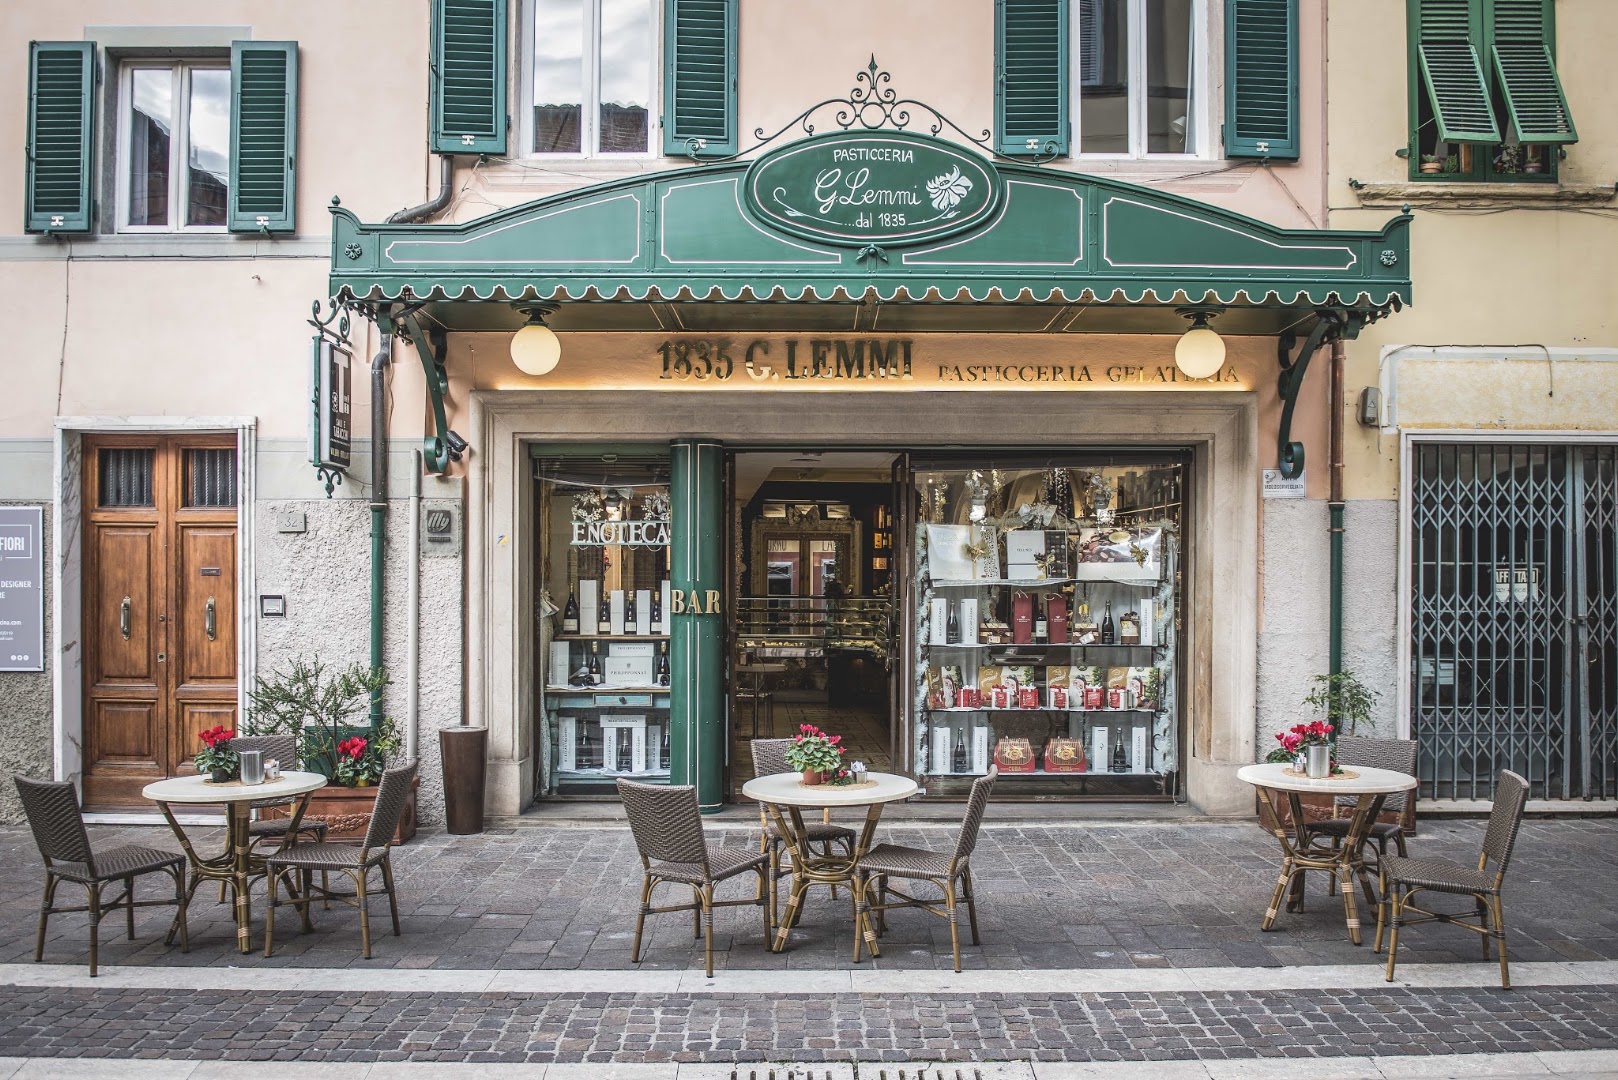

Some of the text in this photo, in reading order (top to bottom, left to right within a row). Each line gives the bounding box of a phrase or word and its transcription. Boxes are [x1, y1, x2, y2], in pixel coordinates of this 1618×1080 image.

[833, 149, 913, 163] PASTICCERIA
[877, 213, 906, 227] 1835
[656, 340, 734, 381] 1835
[937, 365, 1093, 382] PASTICCERIA
[1106, 365, 1239, 382] GELATIA
[284, 517, 298, 528] 32
[427, 512, 450, 532] illy
[571, 522, 669, 544] ENOTECA
[0, 580, 32, 588] DESIGNER
[670, 589, 721, 614] BAR
